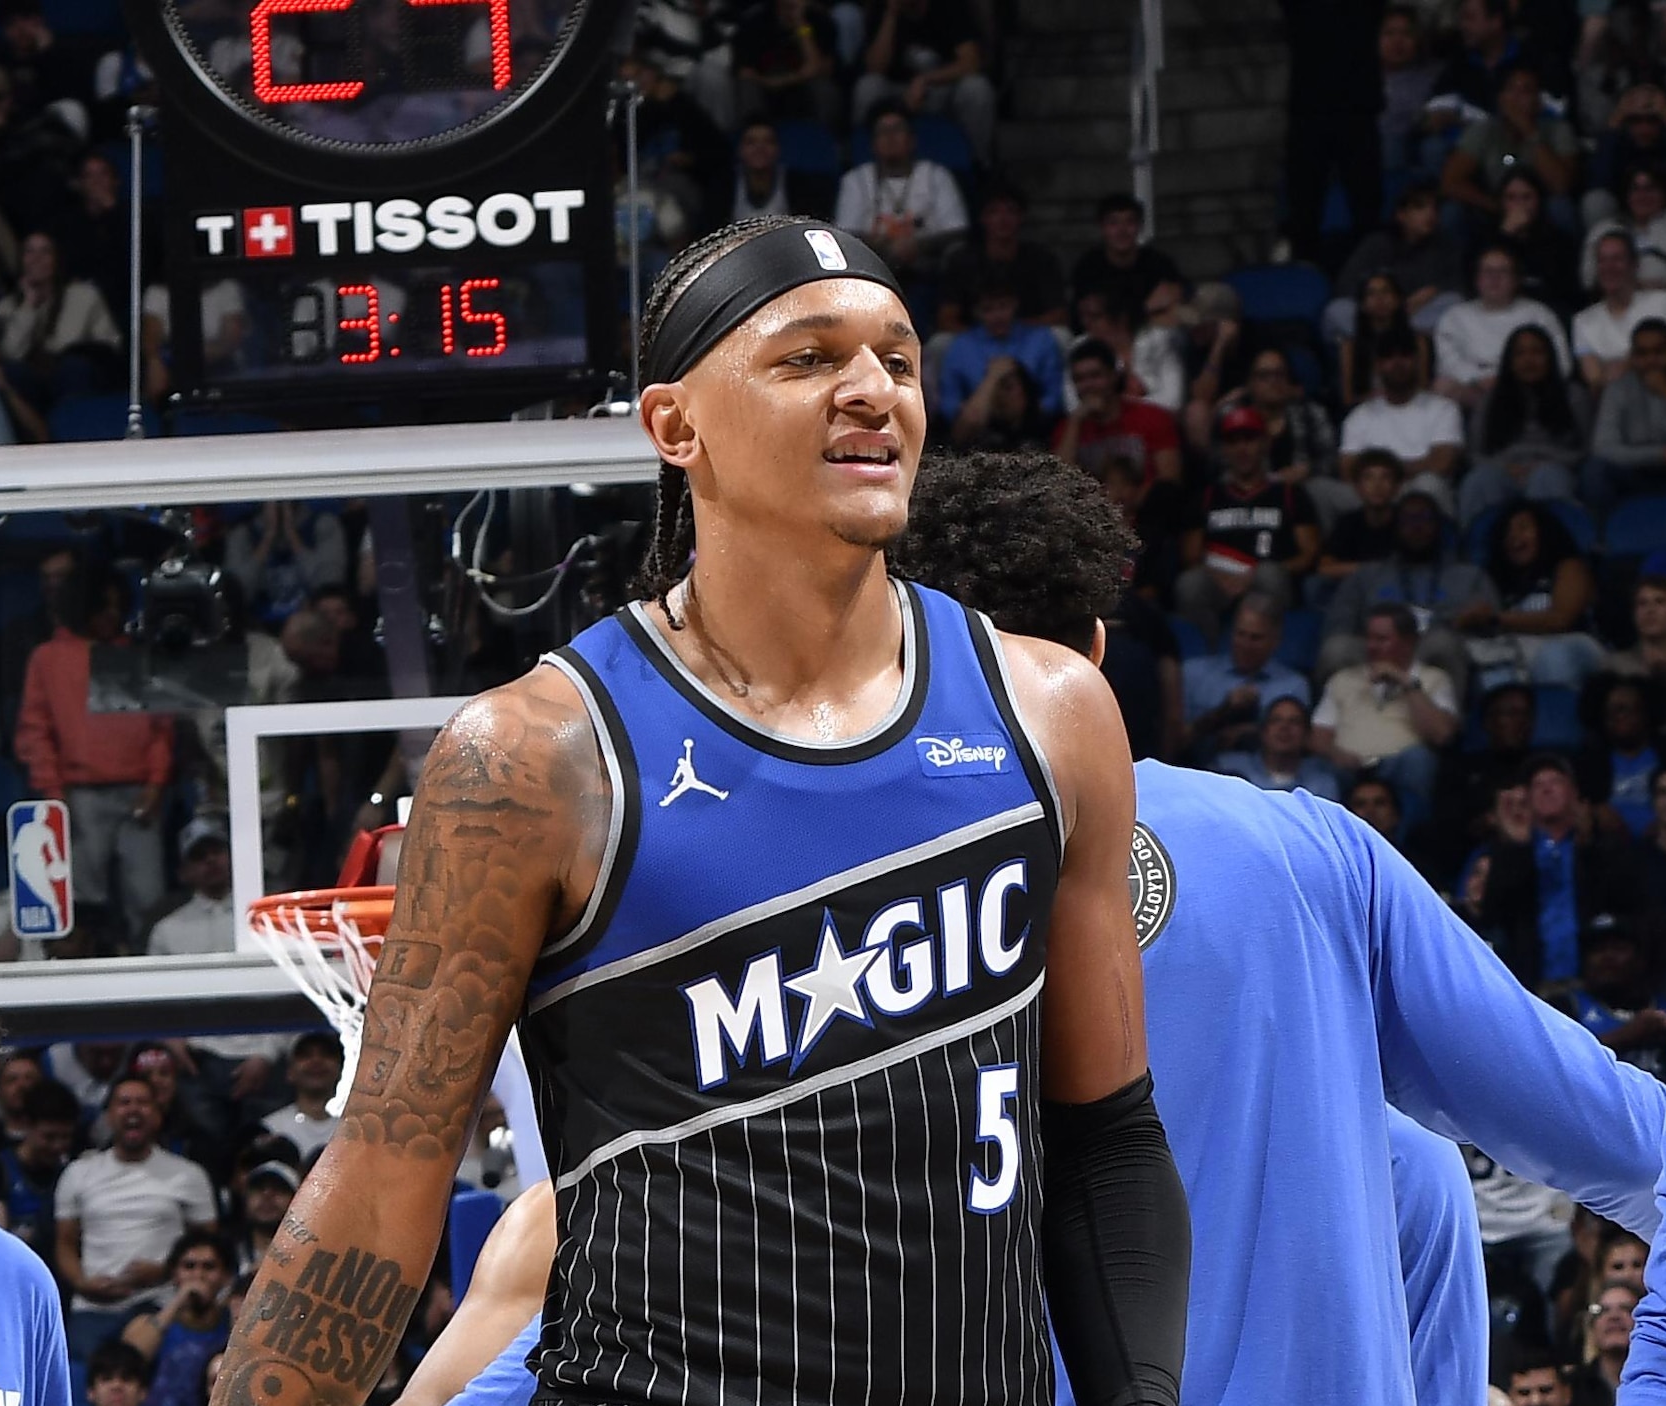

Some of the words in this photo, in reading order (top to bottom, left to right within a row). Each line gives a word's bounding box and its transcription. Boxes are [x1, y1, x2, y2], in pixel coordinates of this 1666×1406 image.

[301, 188, 585, 255] TISSOT
[337, 279, 507, 364] 3:15
[1138, 868, 1164, 926] LLOYD
[967, 1062, 1021, 1216] 5
